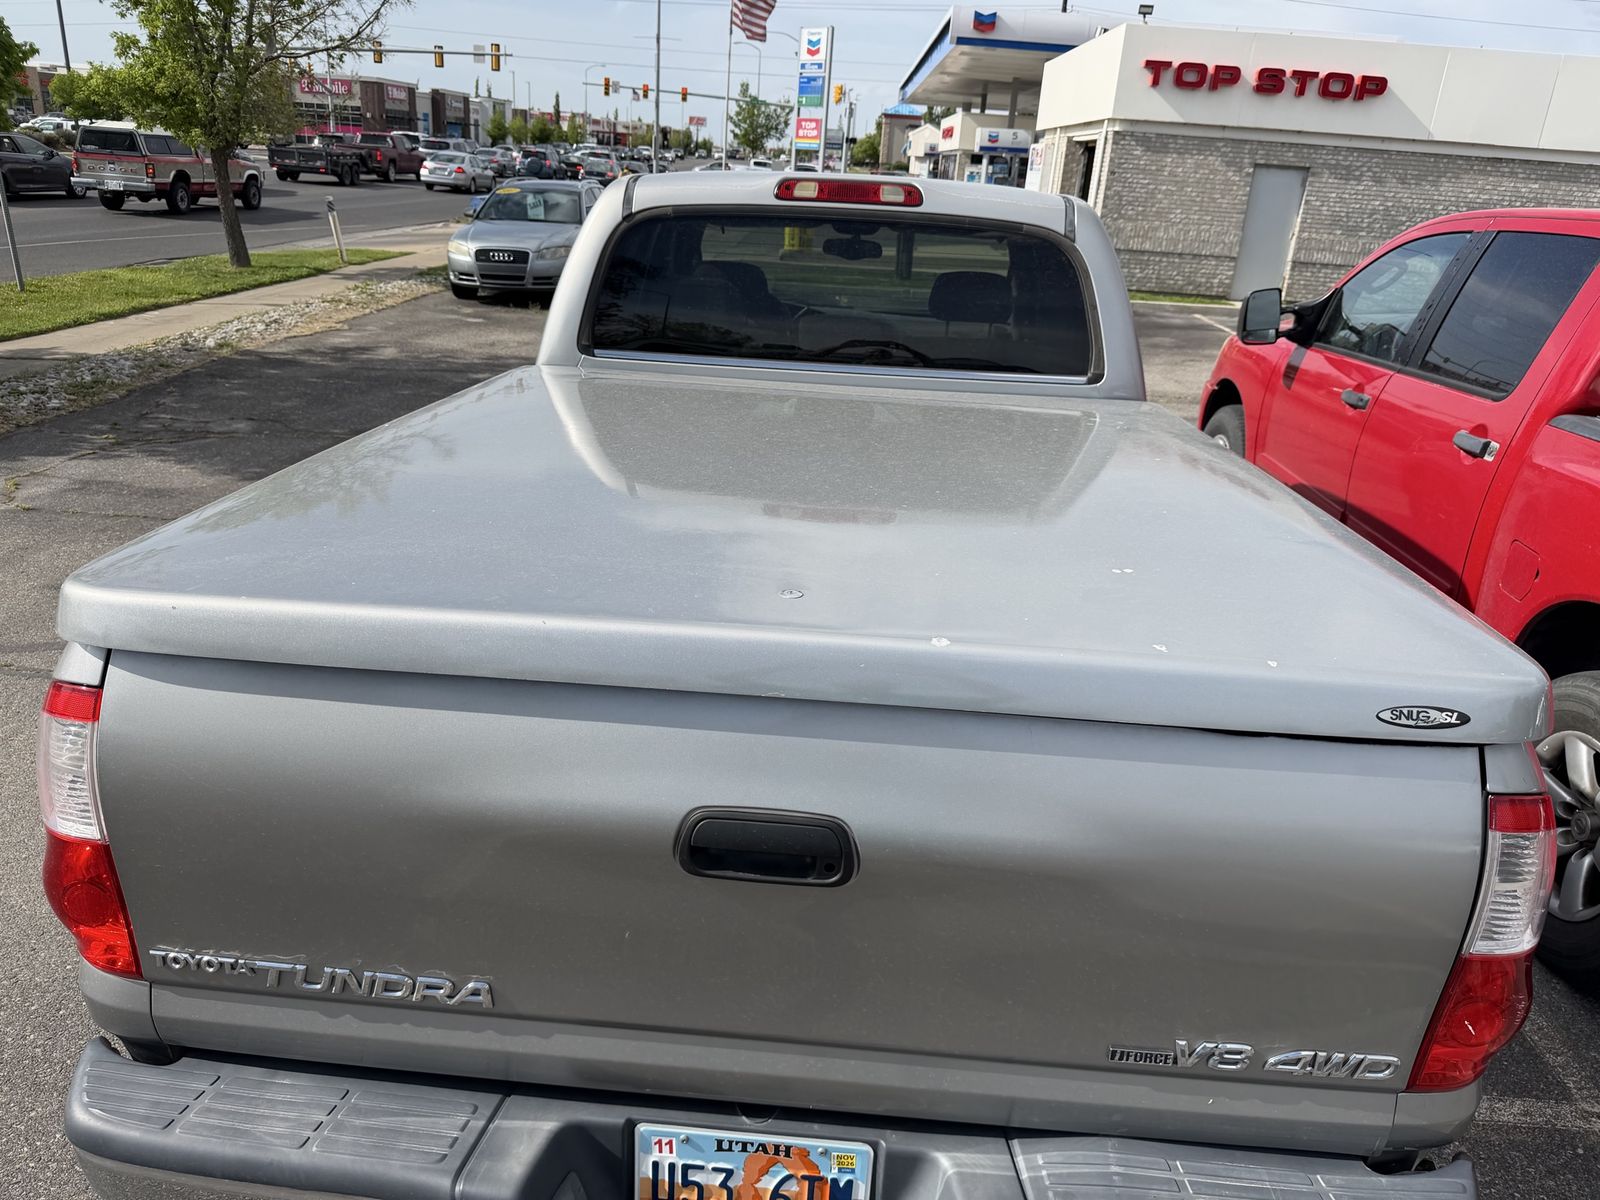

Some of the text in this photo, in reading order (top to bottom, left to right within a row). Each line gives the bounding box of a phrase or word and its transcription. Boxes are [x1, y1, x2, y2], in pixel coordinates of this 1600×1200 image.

[1144, 59, 1389, 102] TOP STOP
[798, 129, 818, 137] STOP
[801, 121, 817, 129] TOP
[1390, 709, 1461, 723] SNUG SL
[150, 948, 495, 1009] TOYOTA TUNDRA
[1175, 1039, 1256, 1072] V8
[1263, 1050, 1401, 1080] 4WD
[653, 1138, 674, 1155] 11
[714, 1138, 794, 1159] UTAH
